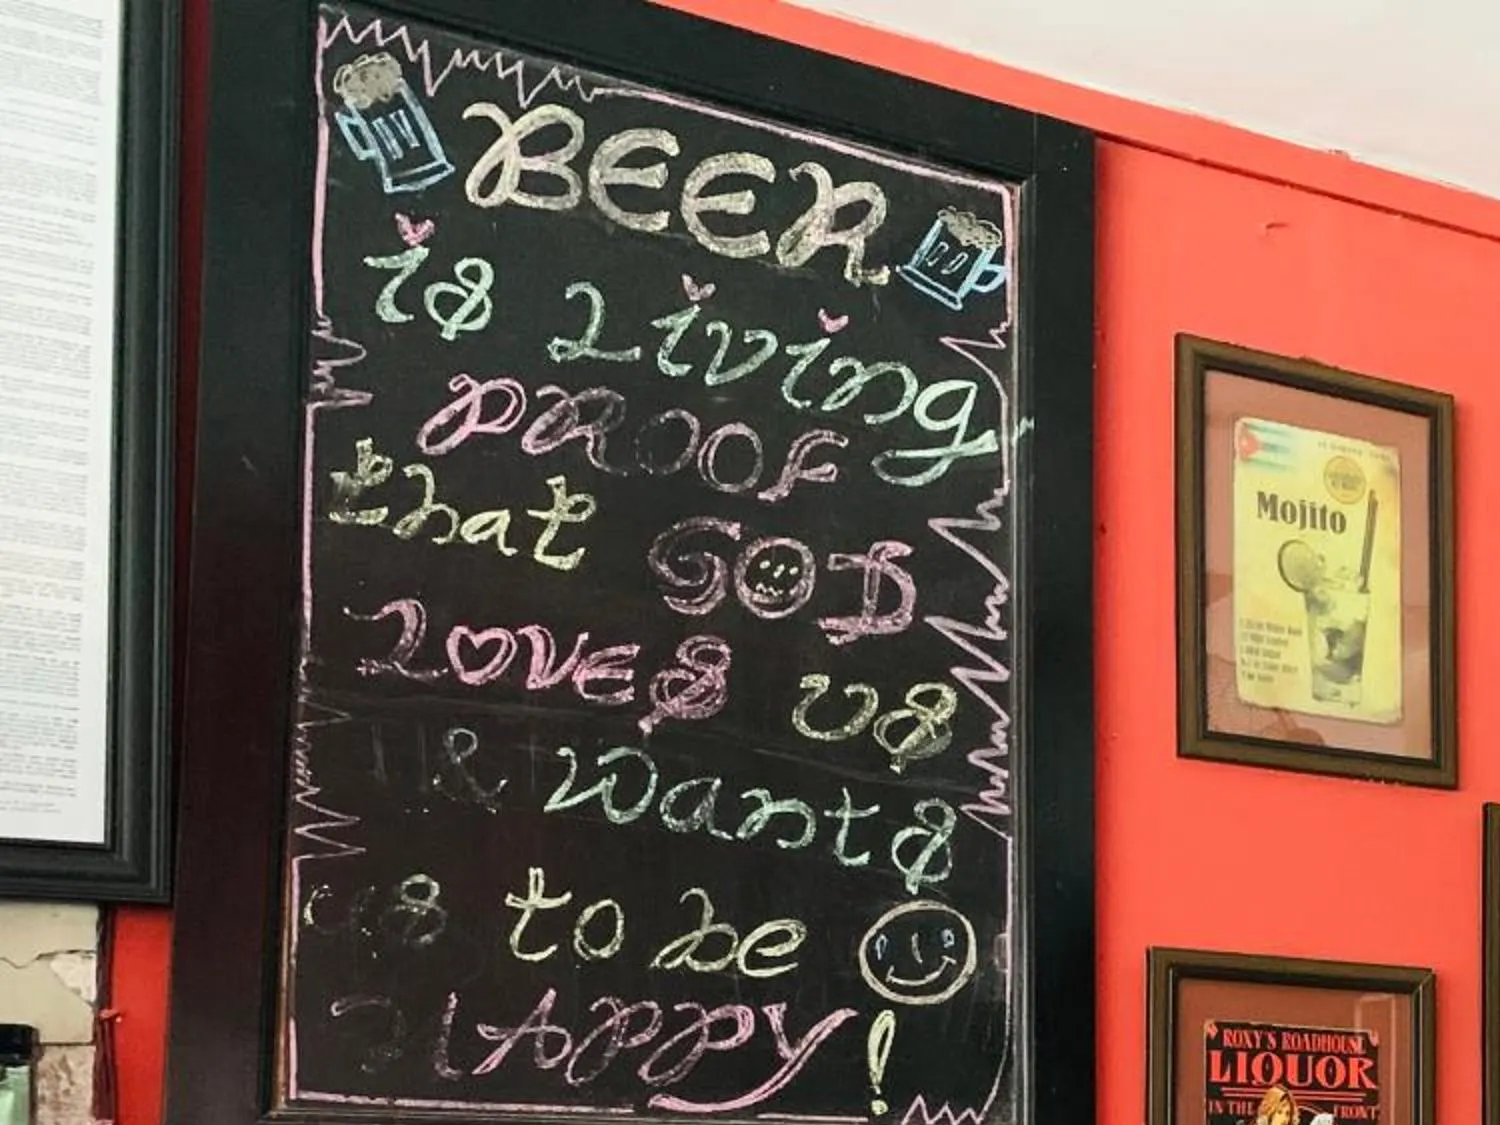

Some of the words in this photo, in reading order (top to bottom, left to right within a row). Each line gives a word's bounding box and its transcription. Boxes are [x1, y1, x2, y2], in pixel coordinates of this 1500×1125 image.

[462, 102, 890, 288] BEER
[1256, 491, 1347, 535] Mojito
[504, 867, 626, 961] to
[1210, 1050, 1377, 1089] LIQUOR
